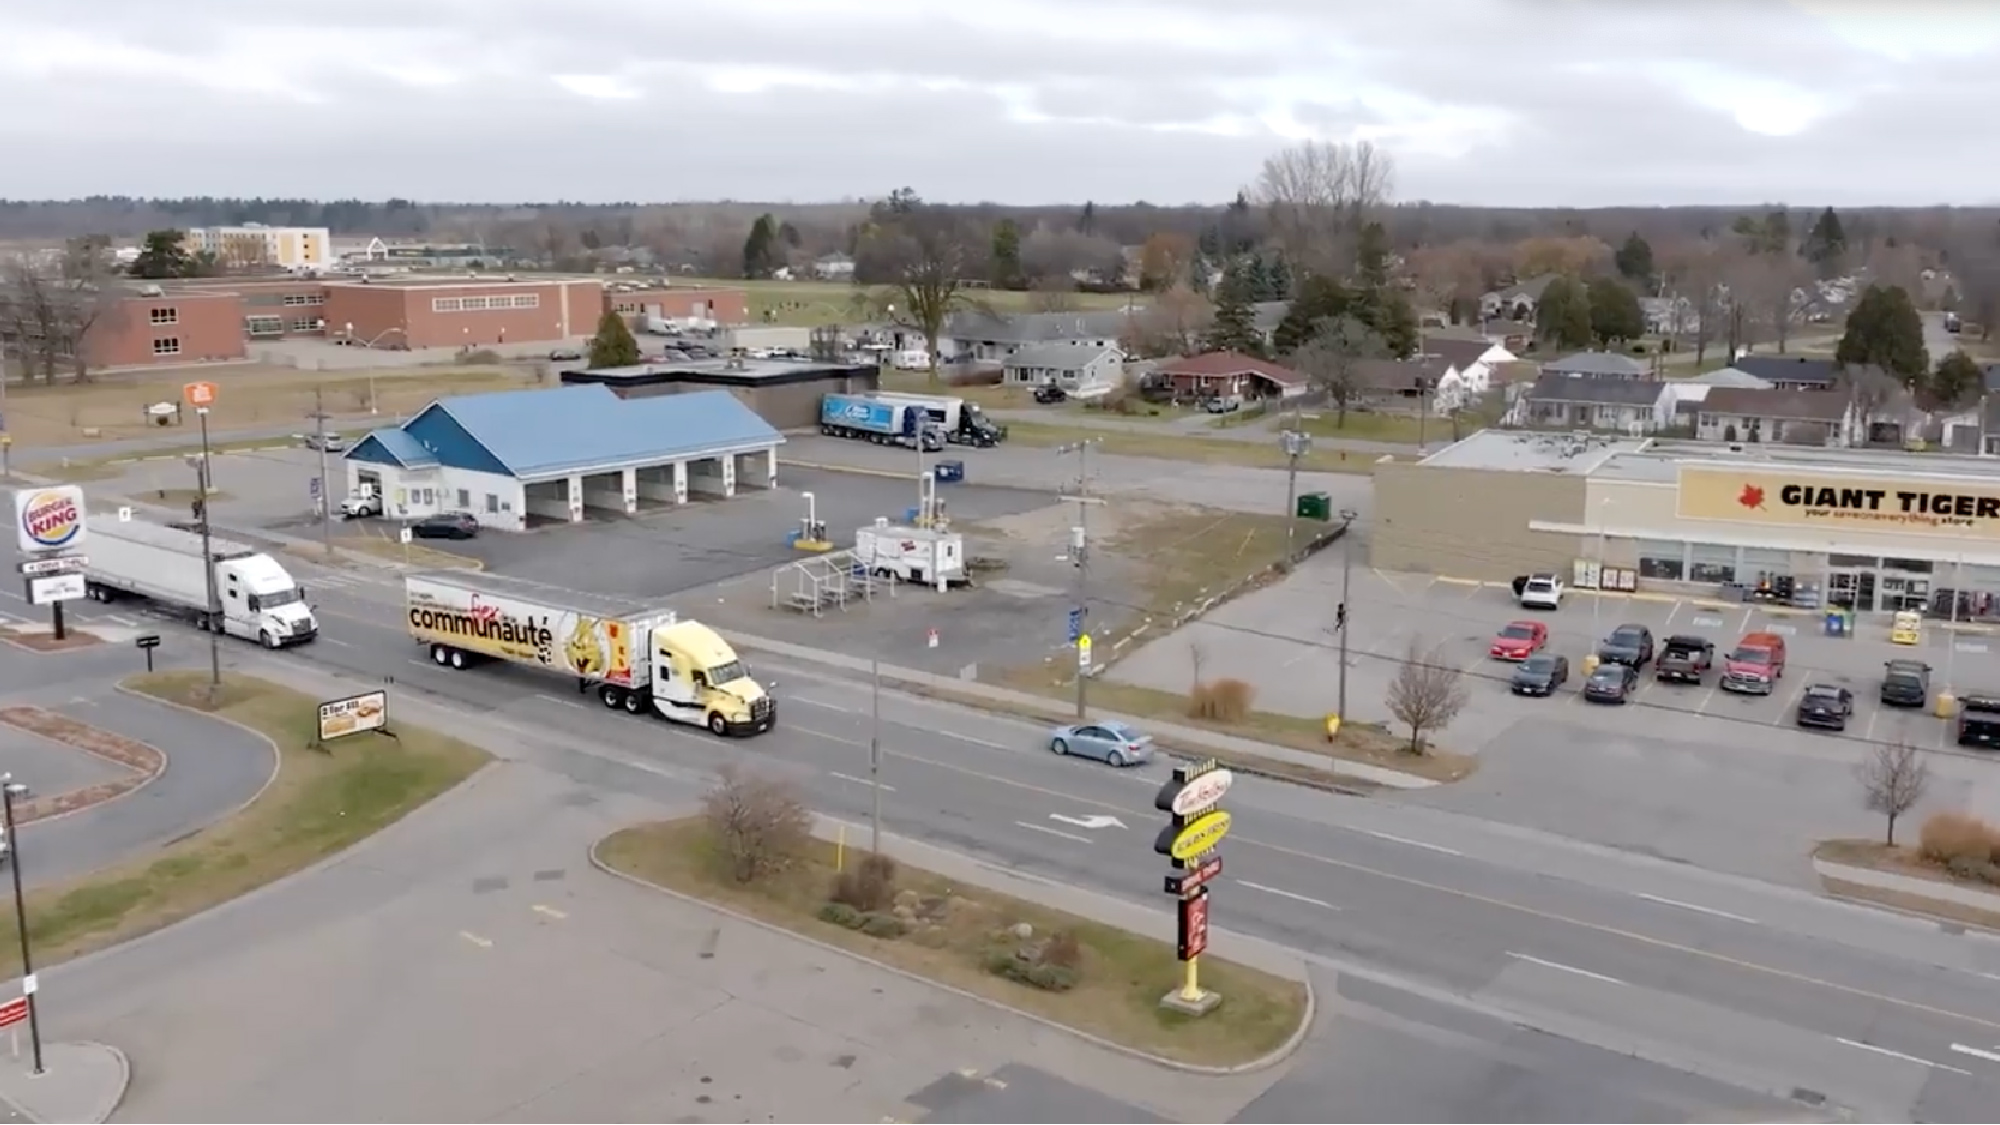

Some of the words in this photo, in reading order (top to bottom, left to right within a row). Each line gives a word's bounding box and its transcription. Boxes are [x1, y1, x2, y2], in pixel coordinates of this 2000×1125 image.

[28, 496, 73, 523] BURGER
[1781, 484, 1885, 510] GIANT
[1896, 491, 2000, 519] TIGER
[33, 507, 77, 535] KING
[1805, 508, 1831, 518] your
[1941, 516, 1974, 527] store
[410, 608, 553, 647] communauté
